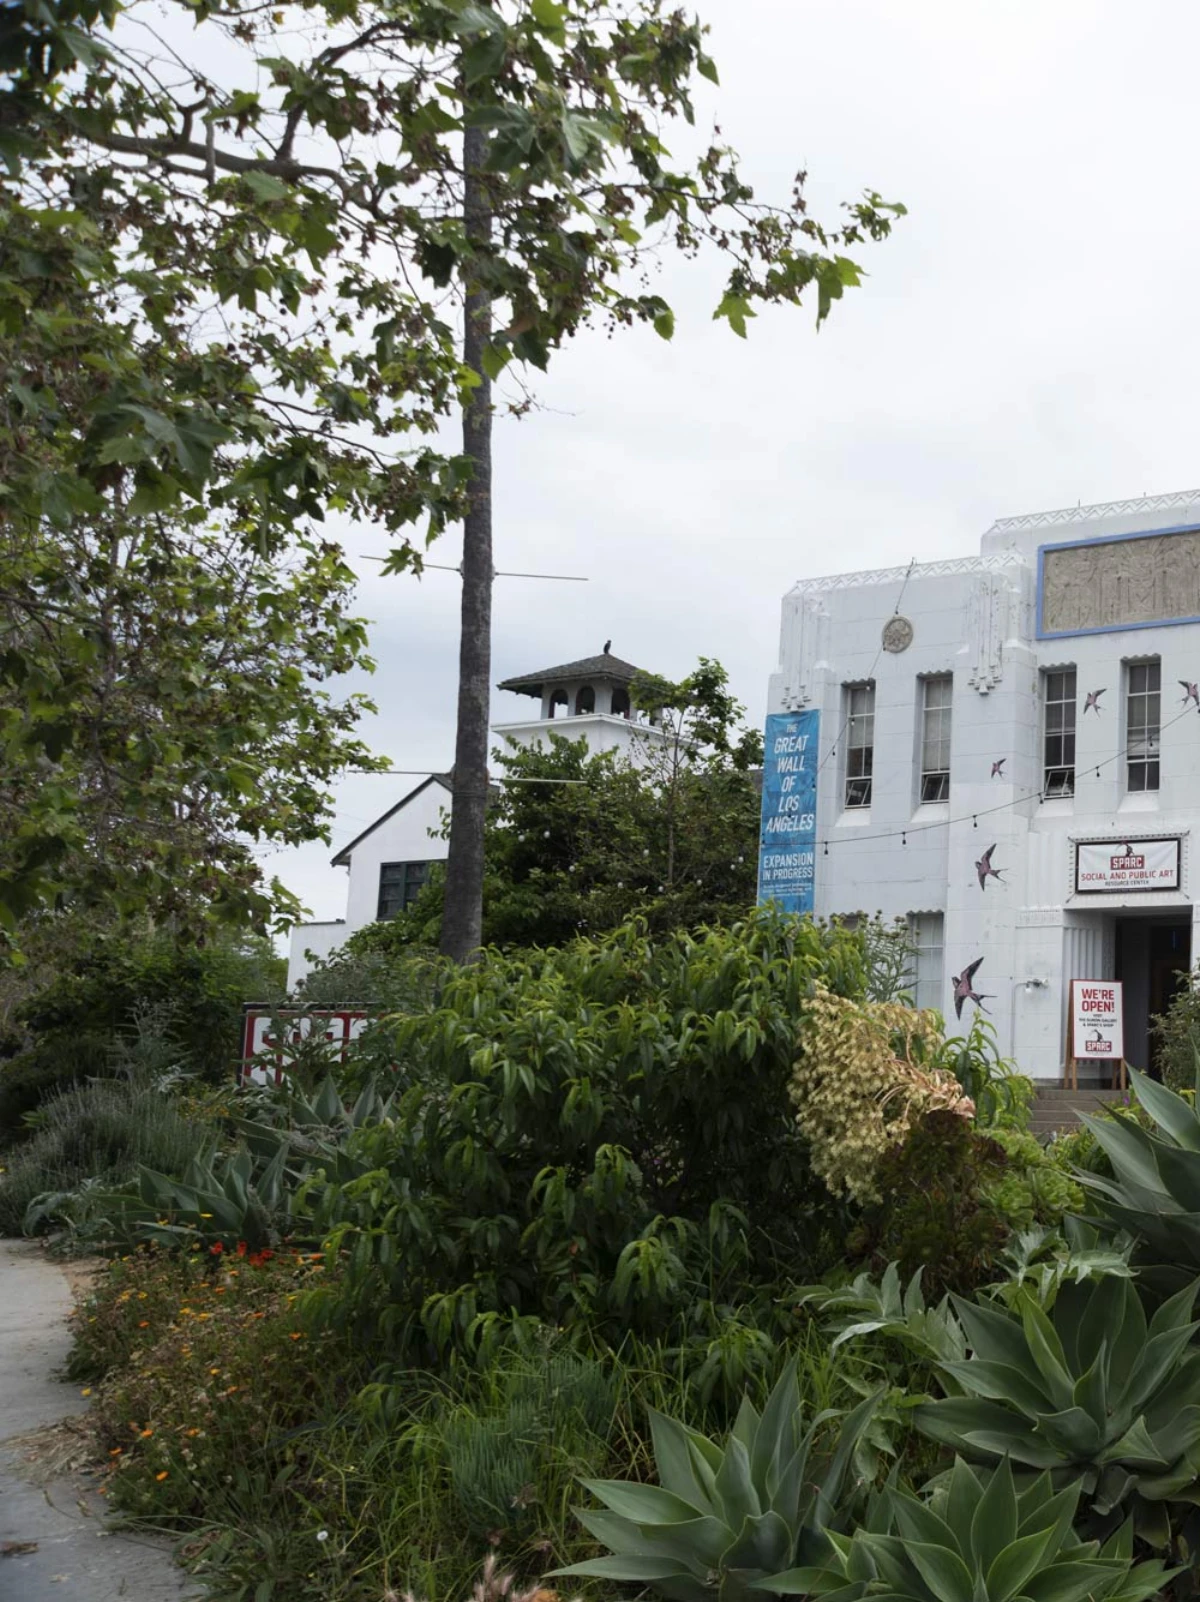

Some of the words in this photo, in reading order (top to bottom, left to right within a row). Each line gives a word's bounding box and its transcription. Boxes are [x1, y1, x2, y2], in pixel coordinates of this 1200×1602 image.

[786, 723, 797, 733] THE
[773, 735, 810, 754] GREAT
[777, 755, 805, 773] WALL
[781, 776, 797, 793] OF
[778, 796, 800, 813] LOS
[766, 814, 814, 833] ANGELES
[763, 852, 813, 869] EXPANSION
[1112, 857, 1142, 869] SPARC
[762, 868, 771, 881] IN
[773, 867, 813, 881] PROGRESS
[1081, 872, 1107, 881] SOCIAL
[1110, 872, 1126, 880] AND
[1129, 870, 1156, 879] PUBLIC
[1159, 869, 1173, 878] ART
[1081, 988, 1115, 1000] WE'RE
[1081, 1000, 1115, 1013] OPEN!
[1086, 1042, 1111, 1051] SPARC
